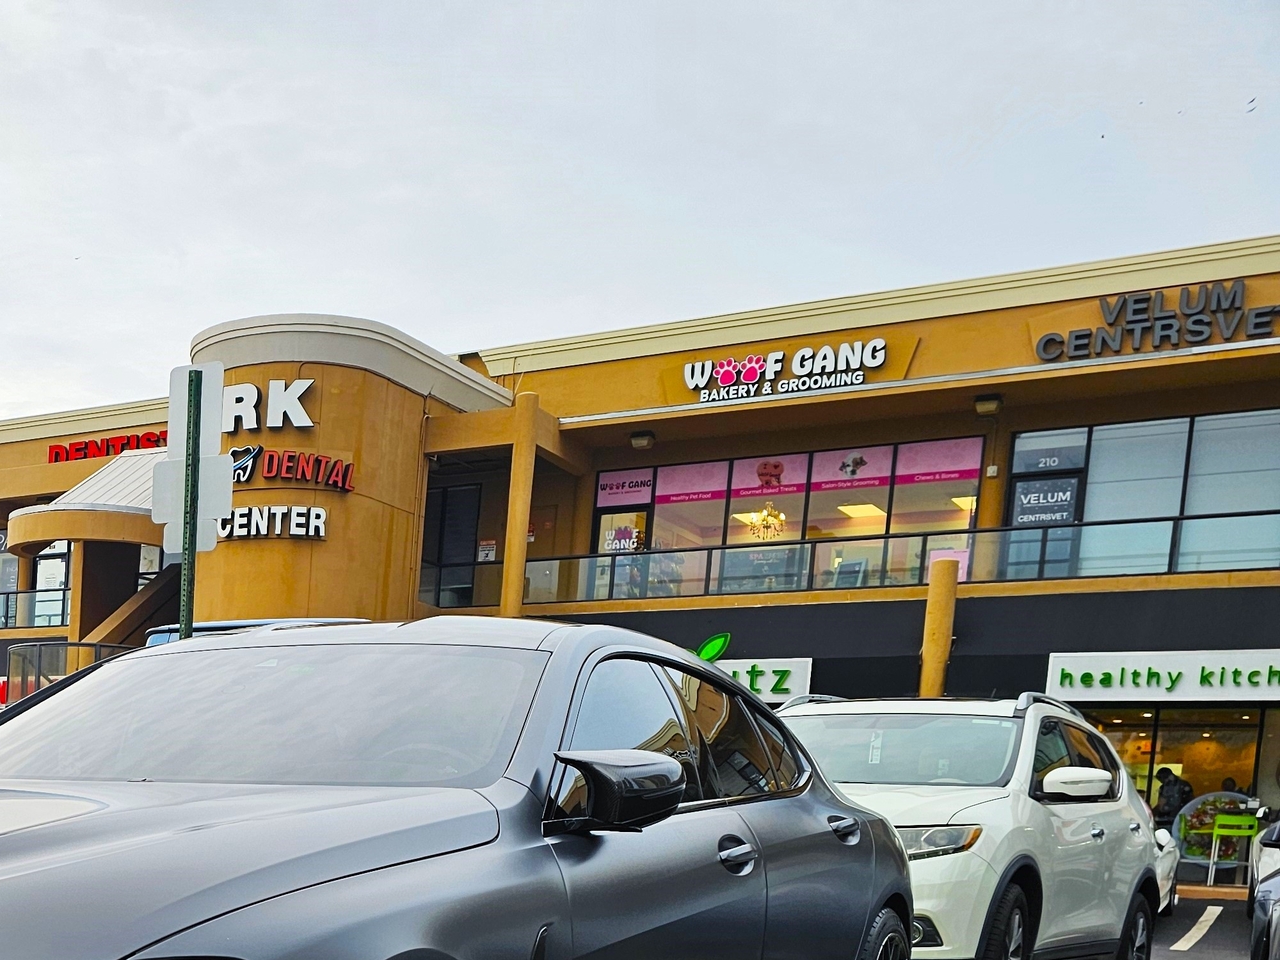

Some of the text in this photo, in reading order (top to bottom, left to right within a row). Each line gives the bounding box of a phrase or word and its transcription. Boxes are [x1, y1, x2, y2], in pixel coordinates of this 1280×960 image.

[1099, 280, 1245, 325] VELUM
[792, 338, 886, 375] GANG
[700, 371, 864, 402] BAKERY & GROOMING
[262, 451, 355, 491] DENTAL
[1038, 457, 1059, 468] 210
[628, 480, 652, 489] GANG
[821, 479, 879, 489] Salon-Style Grooming
[1020, 491, 1071, 504] VELUM
[217, 506, 327, 538] CENTER
[1018, 512, 1068, 522] CENTRSVET
[604, 539, 637, 550] GANG
[732, 664, 792, 695] tz
[1059, 667, 1183, 692] healthy
